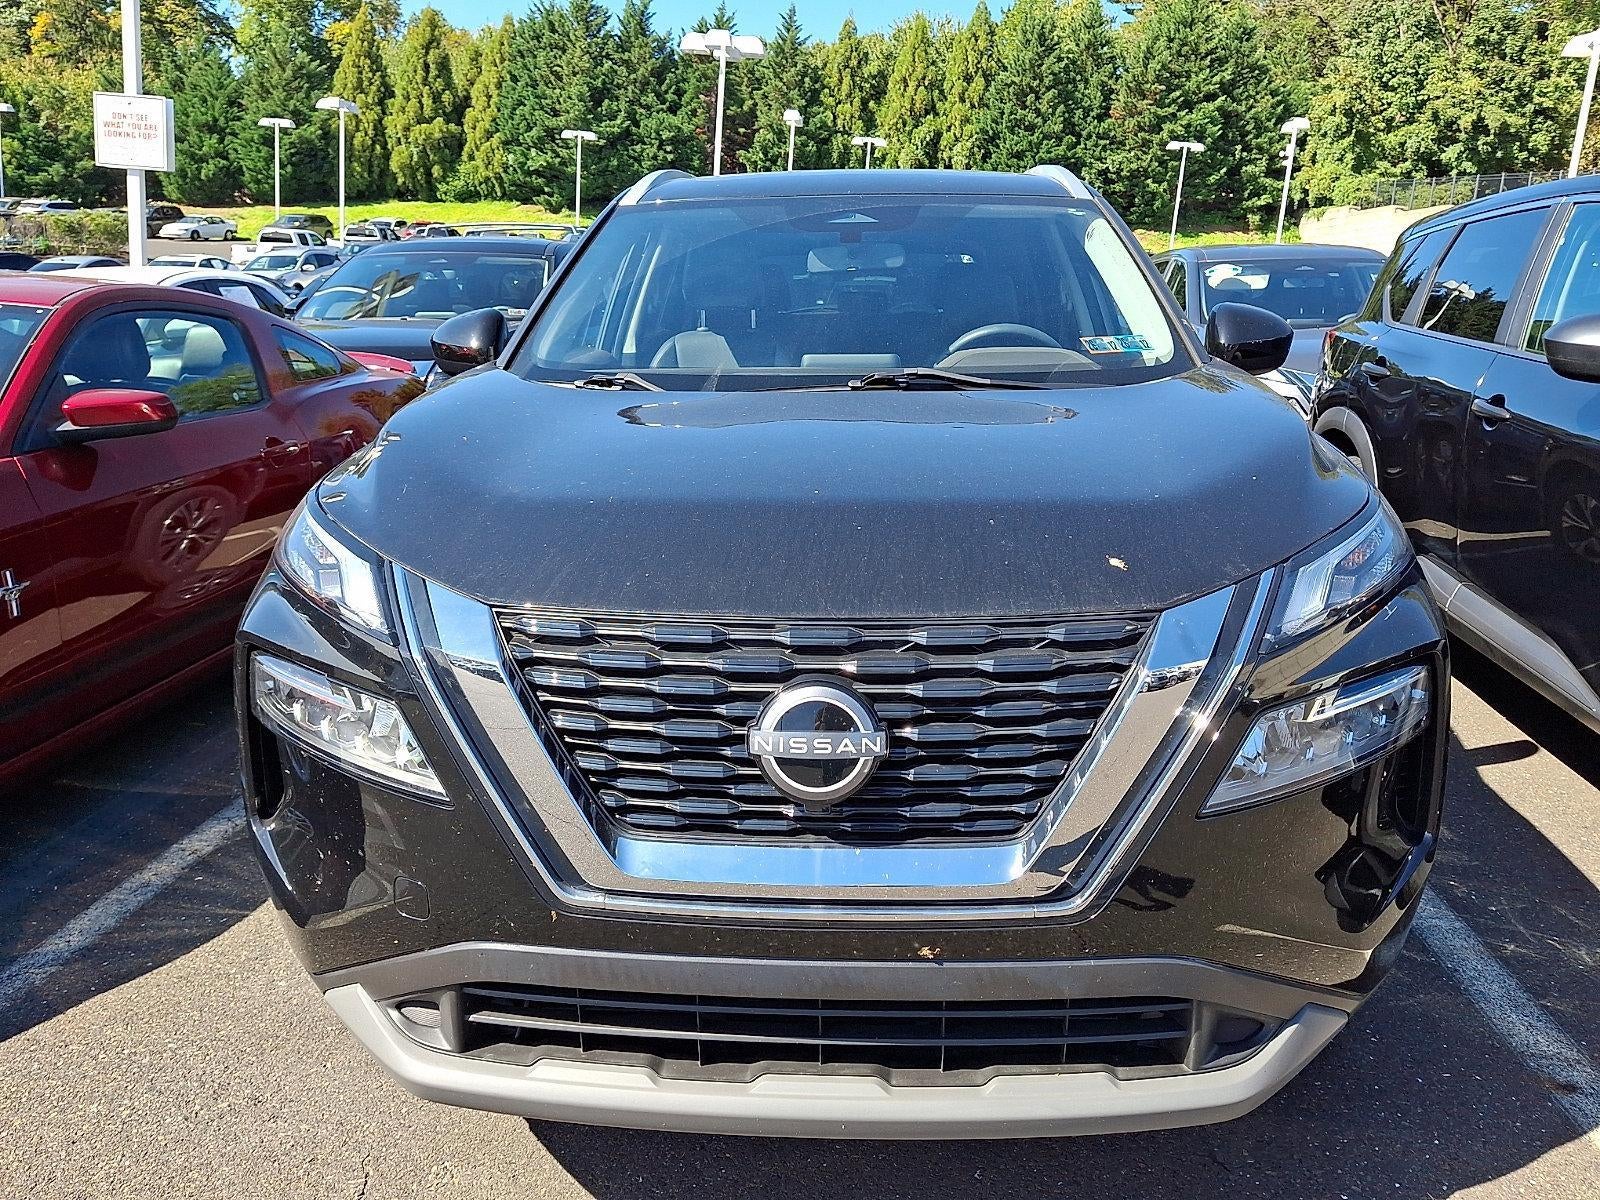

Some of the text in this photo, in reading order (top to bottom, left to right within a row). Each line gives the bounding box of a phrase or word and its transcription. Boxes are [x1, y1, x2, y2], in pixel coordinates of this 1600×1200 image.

[136, 114, 148, 122] SEE
[144, 124, 158, 132] ARE
[104, 130, 136, 138] LOOKING
[754, 736, 881, 754] NISSAN
